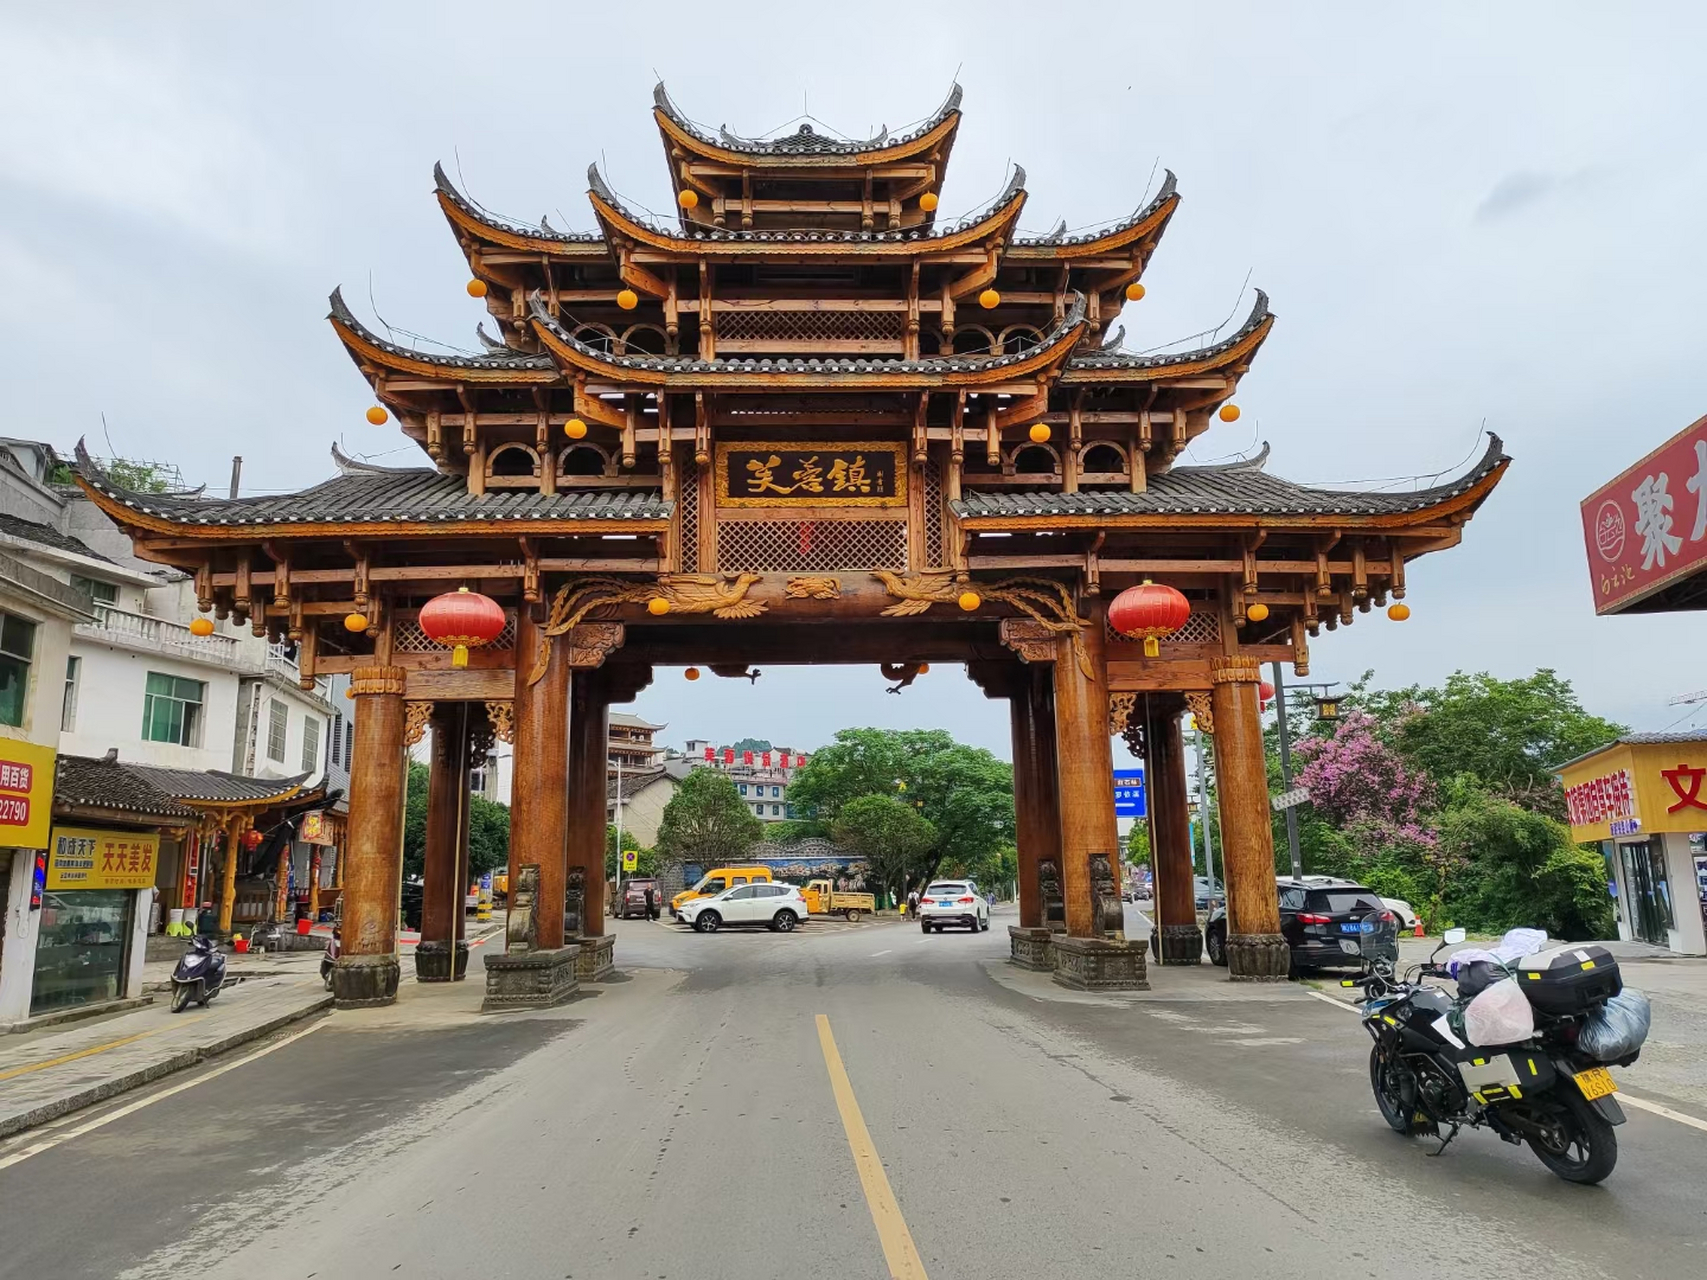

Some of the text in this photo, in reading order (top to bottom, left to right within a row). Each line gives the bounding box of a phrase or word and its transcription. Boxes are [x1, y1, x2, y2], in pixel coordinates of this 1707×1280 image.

[0, 765, 29, 789] 用百货
[1660, 764, 1707, 814] 文
[102, 842, 153, 873] 天天美发
